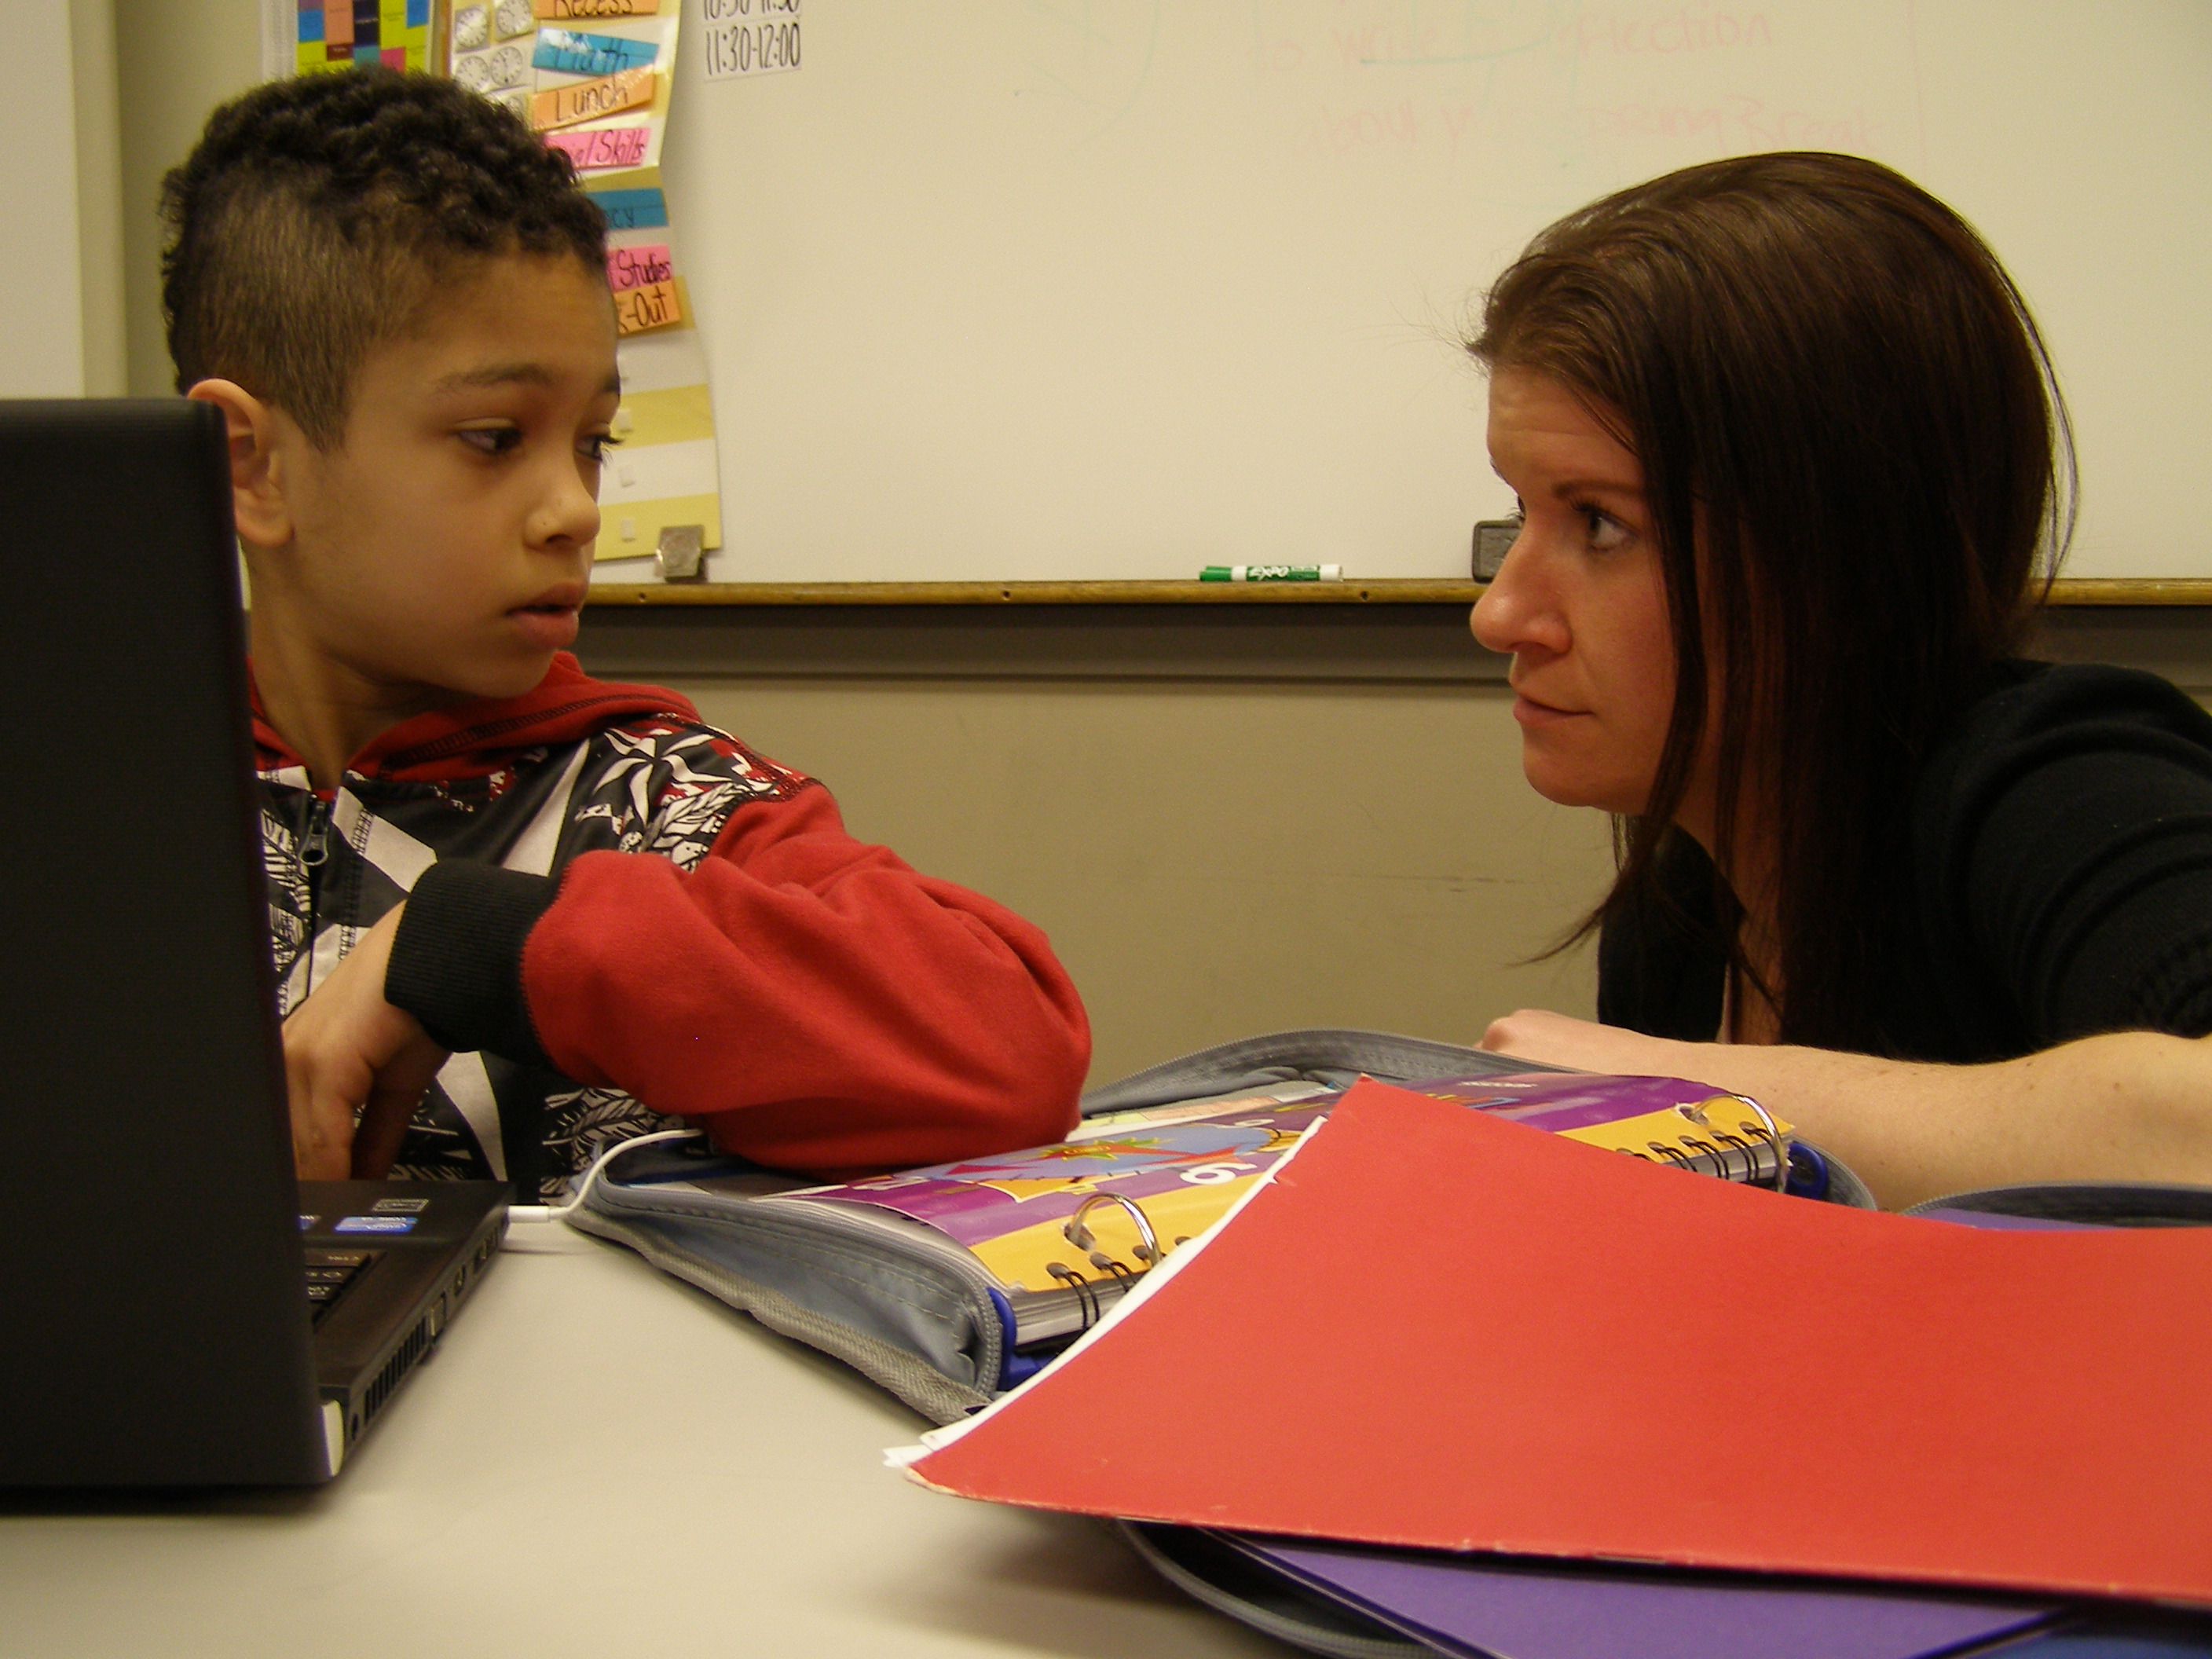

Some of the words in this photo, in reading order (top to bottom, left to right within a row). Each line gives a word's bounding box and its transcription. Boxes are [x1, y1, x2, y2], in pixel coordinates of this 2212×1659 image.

[706, 22, 800, 75] 11:30-12:00
[555, 74, 628, 123] Lunch
[617, 249, 672, 287] Studies
